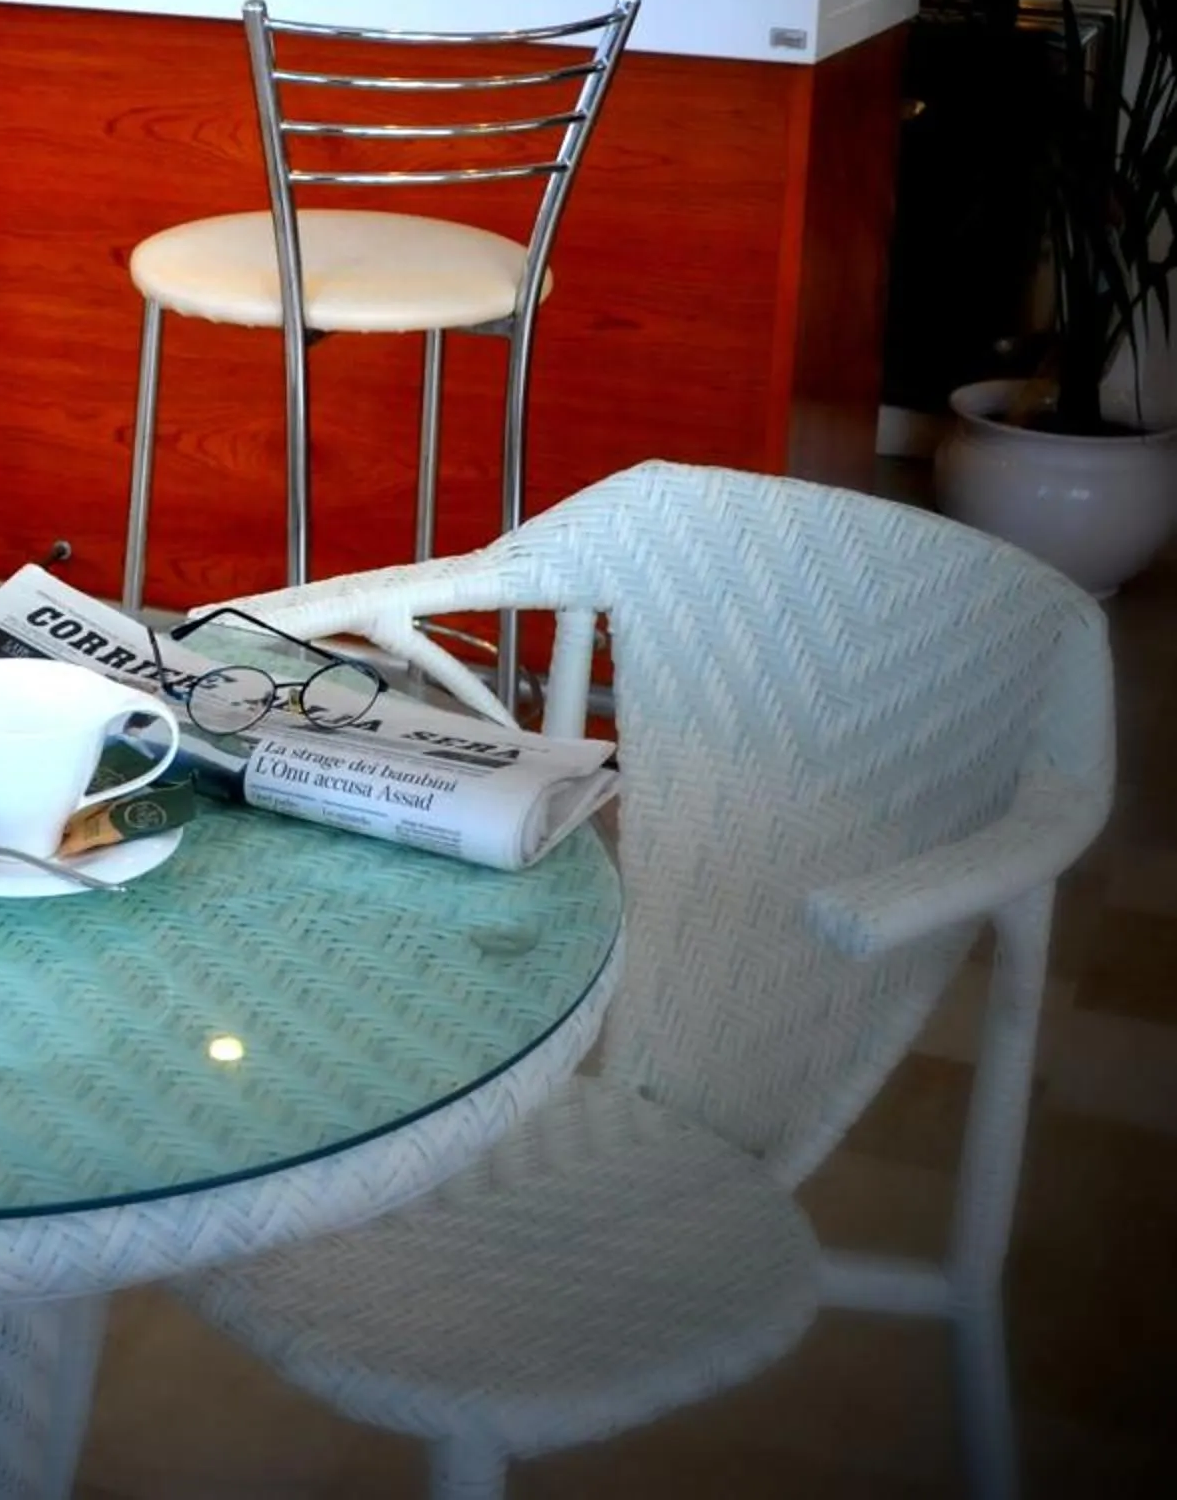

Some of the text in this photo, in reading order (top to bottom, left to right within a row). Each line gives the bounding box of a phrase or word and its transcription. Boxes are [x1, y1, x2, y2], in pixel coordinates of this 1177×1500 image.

[262, 738, 460, 793] La strage dei bambini
[400, 729, 521, 760] SERA
[255, 755, 435, 812] L'Onu accusa Assad
